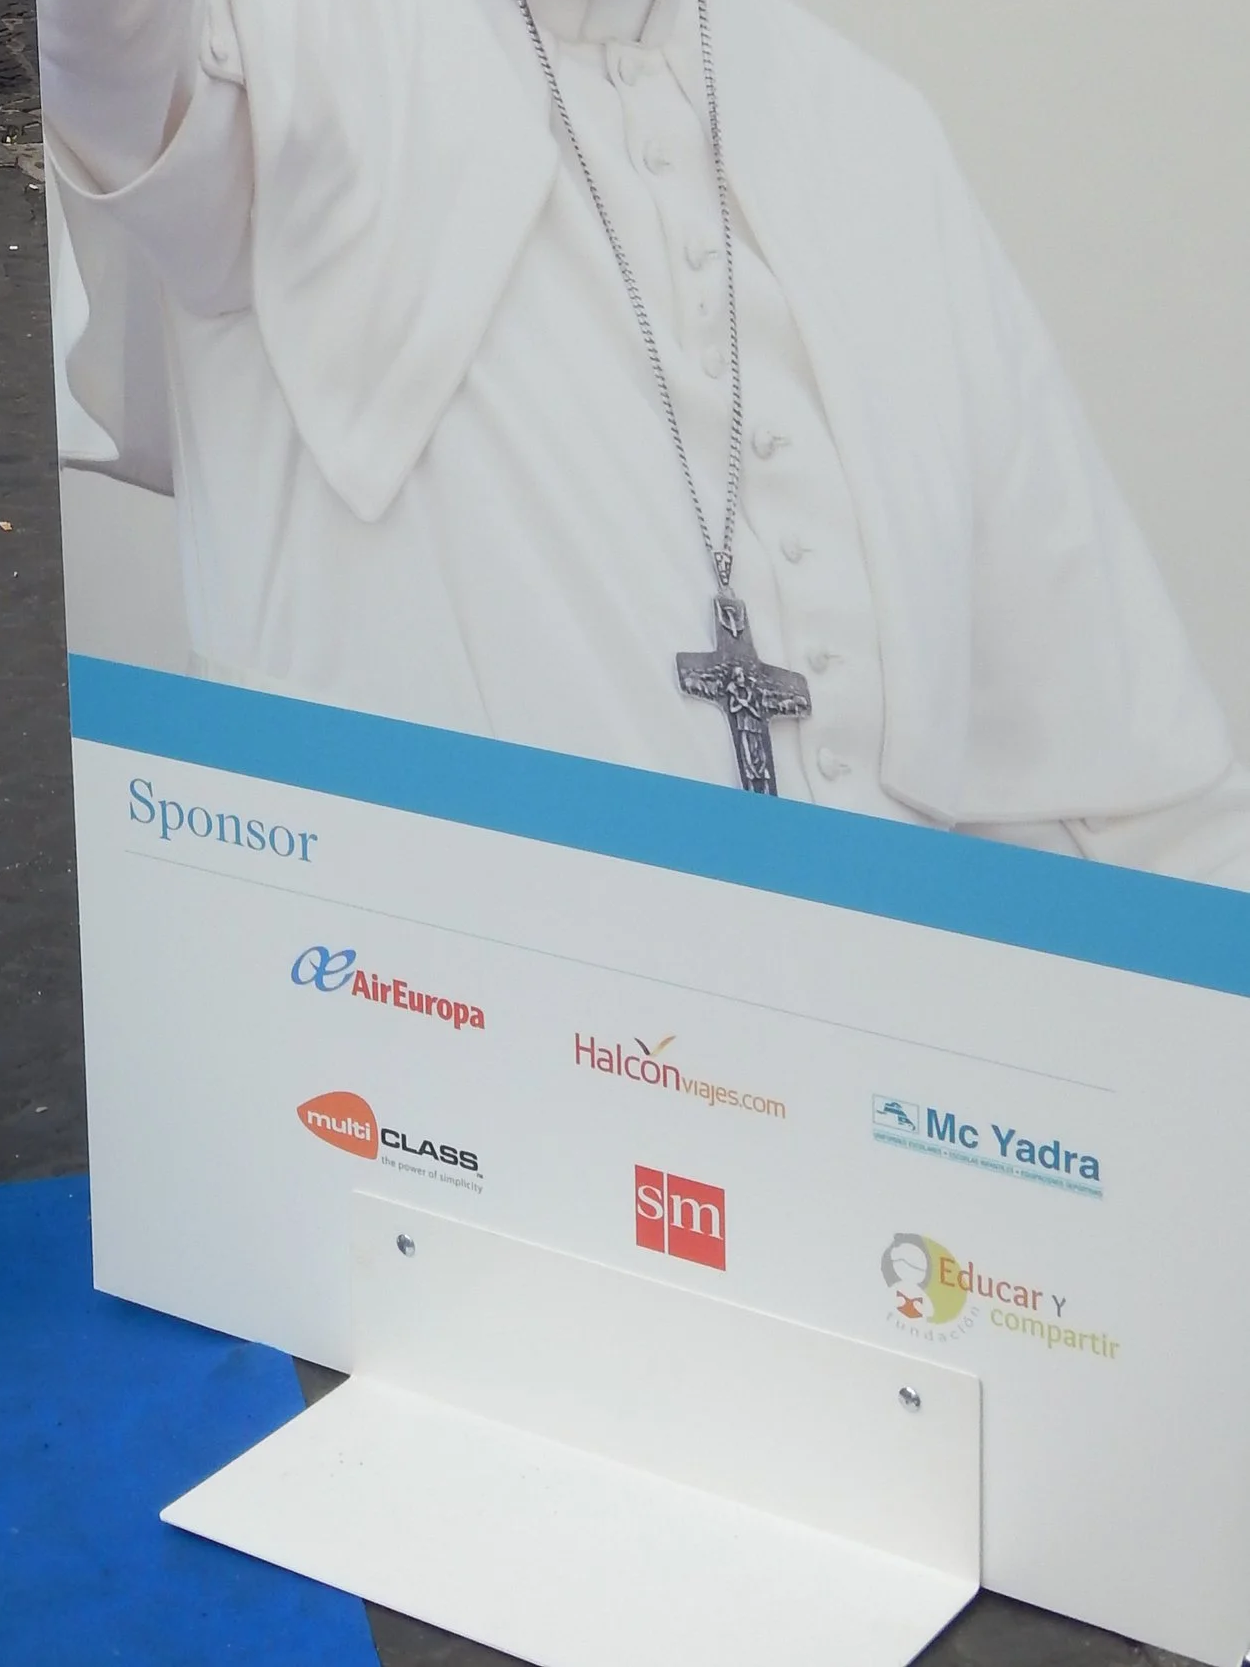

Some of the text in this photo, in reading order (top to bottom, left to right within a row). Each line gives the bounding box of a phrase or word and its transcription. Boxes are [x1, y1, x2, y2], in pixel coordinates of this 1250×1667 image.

[128, 778, 318, 862] Sponsor
[351, 969, 485, 1030] AirEuropa
[307, 1110, 371, 1141] multi
[927, 1108, 979, 1149] Mc
[991, 1124, 1100, 1181] Yadra
[381, 1155, 483, 1194] the power of simplicity
[637, 1184, 723, 1241] sm
[939, 1256, 1043, 1311] Educar
[990, 1308, 1120, 1360] compartir
